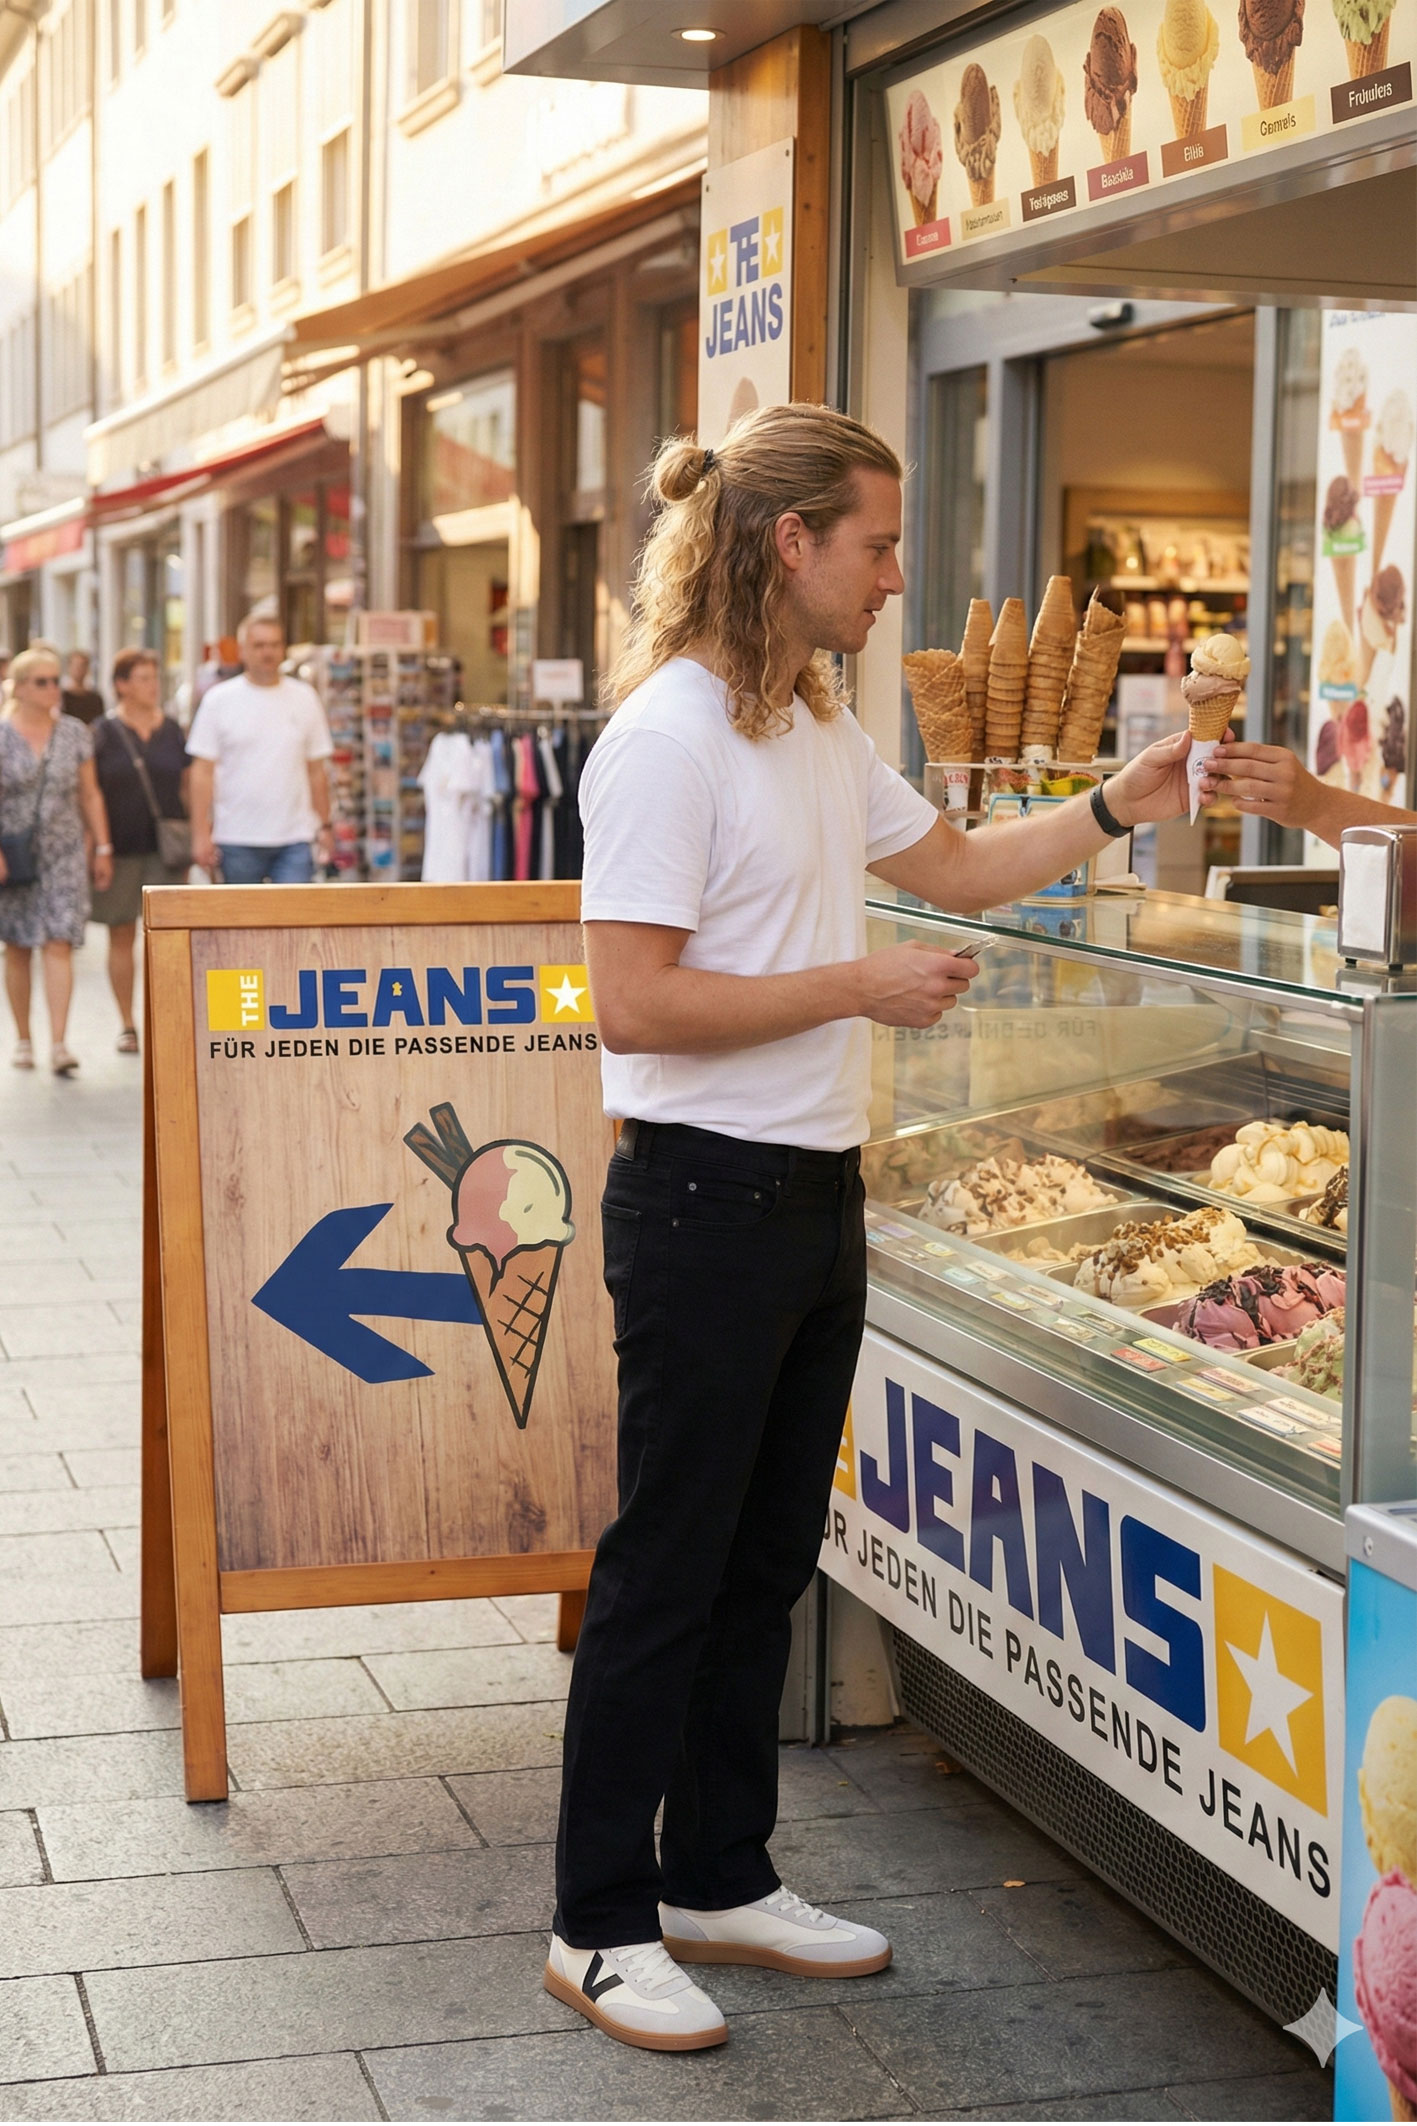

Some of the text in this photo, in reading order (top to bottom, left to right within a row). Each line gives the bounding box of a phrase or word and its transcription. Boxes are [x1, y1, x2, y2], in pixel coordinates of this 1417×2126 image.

[705, 283, 783, 359] JEANS
[239, 966, 536, 1029] THE JEANS
[210, 1033, 598, 1058] FÜR JEDEN DIE PASSENDE JEANS
[859, 1377, 1206, 1733] JEANS
[857, 1528, 938, 1619] JEDEN
[949, 1592, 994, 1659] DIE
[1006, 1628, 1184, 1796] PASSENDE
[1199, 1769, 1331, 1898] JEANS
